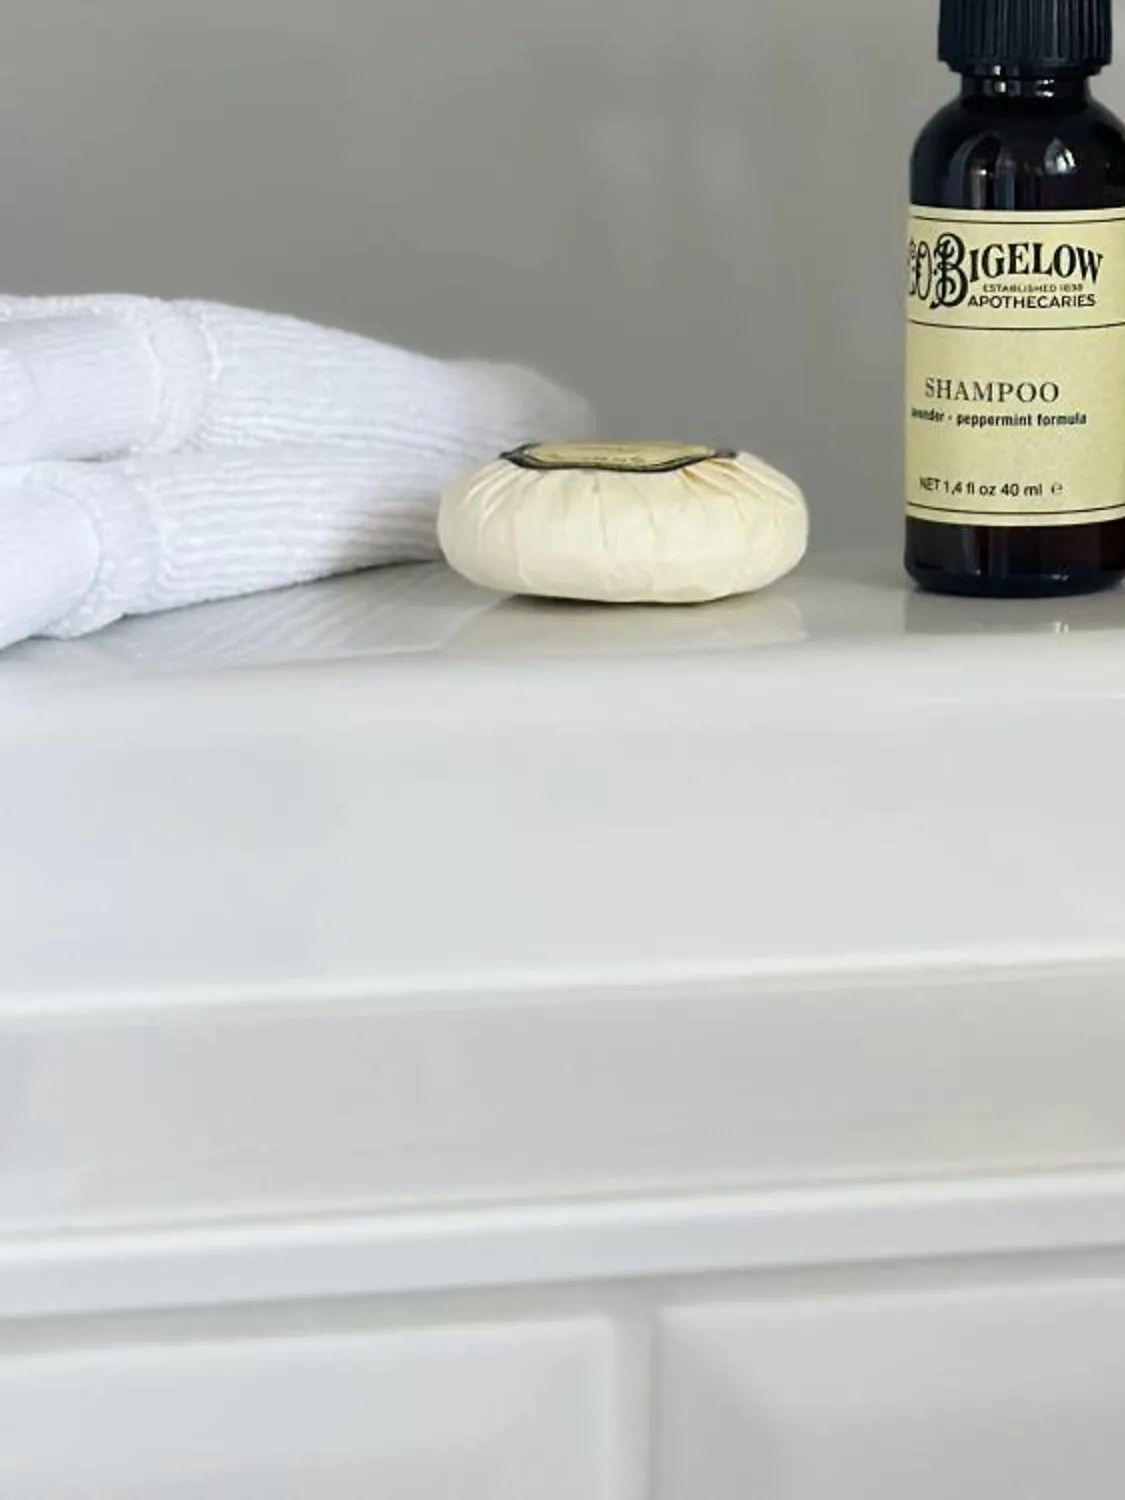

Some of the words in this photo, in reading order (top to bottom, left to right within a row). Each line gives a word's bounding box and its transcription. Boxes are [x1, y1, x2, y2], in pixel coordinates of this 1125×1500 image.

[929, 232, 1104, 309] BIGELOW
[983, 283, 1057, 293] ESTABLISHED
[967, 293, 1096, 309] APOTHECARIES
[925, 377, 1060, 403] SHAMPOO
[956, 412, 1032, 428] peppermint
[1037, 412, 1087, 426] formula
[919, 477, 940, 491] NET
[967, 481, 975, 495] fl
[979, 484, 996, 496] oz
[1001, 483, 1019, 497] 40
[1024, 483, 1042, 497] ml
